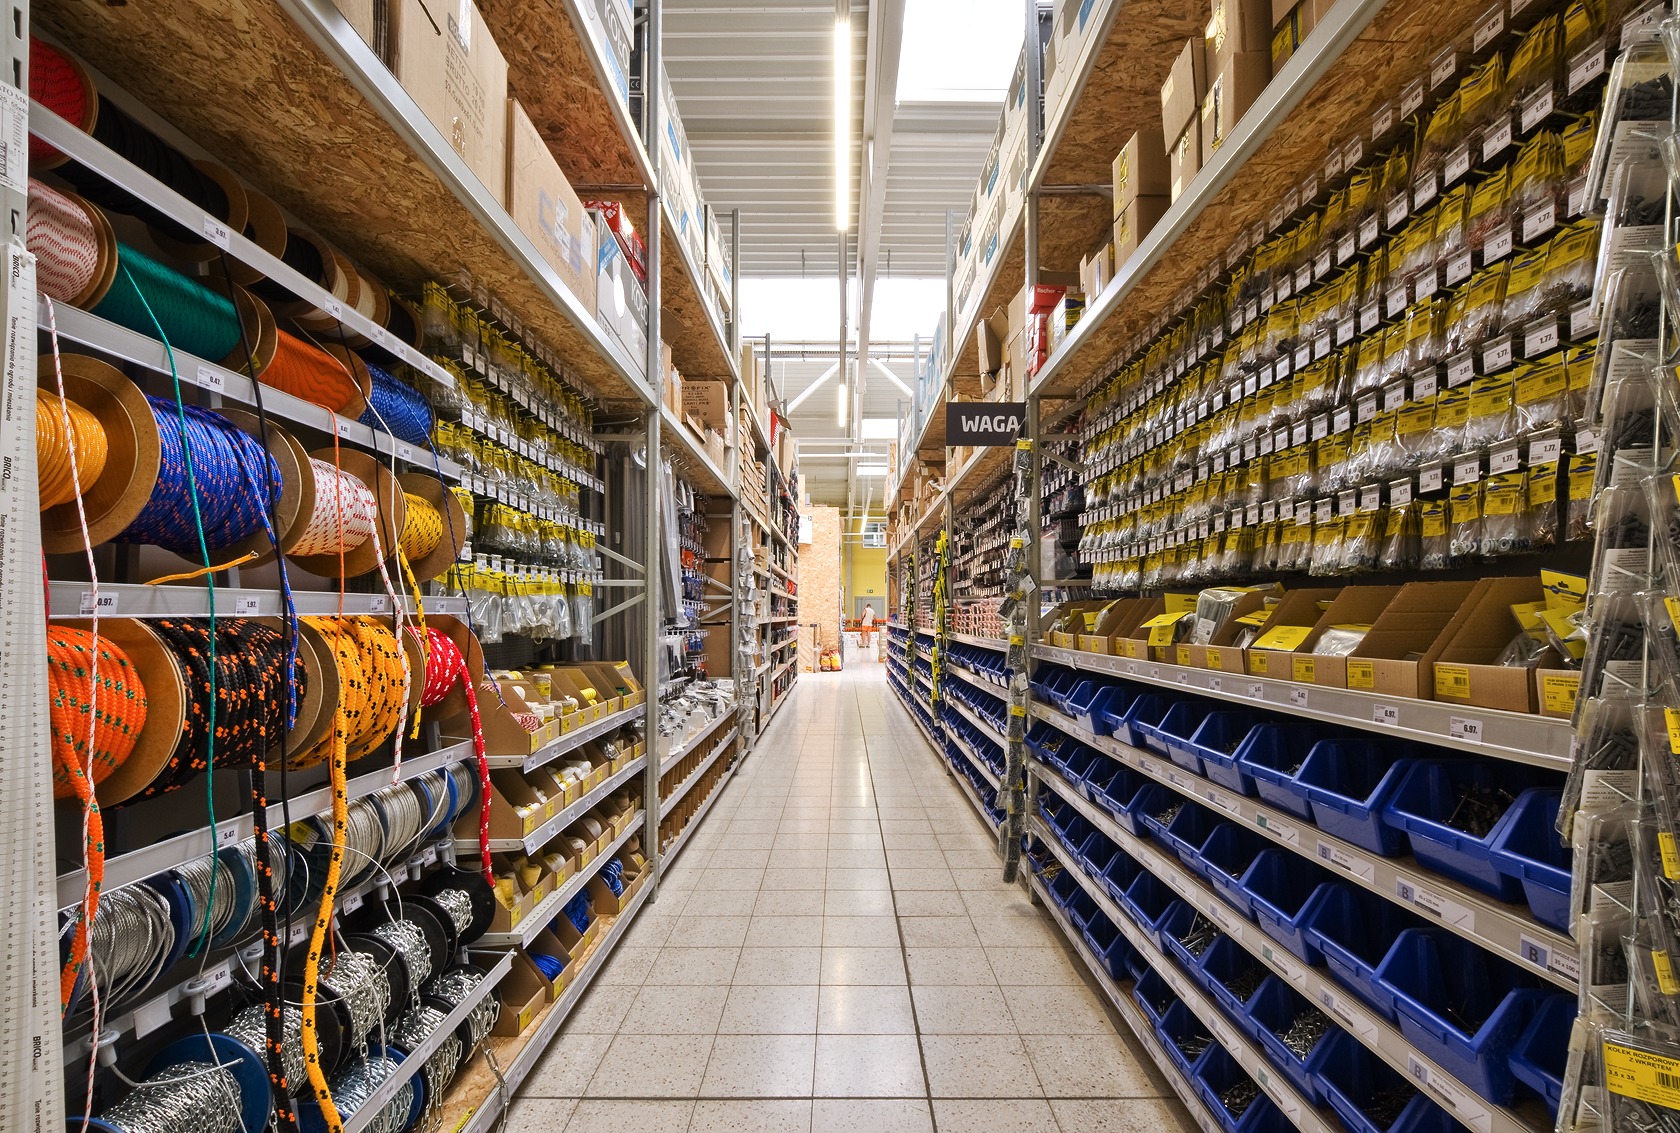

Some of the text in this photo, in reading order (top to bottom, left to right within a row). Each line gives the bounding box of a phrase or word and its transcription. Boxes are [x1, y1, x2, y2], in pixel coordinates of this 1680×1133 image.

[1585, 58, 1600, 73] 1.97.
[446, 56, 469, 96] BRUTTO
[1535, 100, 1549, 113] 1.97.
[1538, 212, 1552, 224] 1.77.
[1497, 238, 1509, 249] 1.77.
[1458, 261, 1468, 271] 1.77.
[1540, 334, 1553, 345] 1.77.
[1497, 348, 1509, 358] 1.77.
[210, 377, 221, 385] 0.47.
[961, 415, 1019, 434] WAGA
[1502, 454, 1514, 463] 1.77.
[97, 598, 113, 606] 0.97.
[1384, 709, 1396, 718] 6.97.
[1464, 725, 1478, 734] 6.97.
[224, 830, 235, 839] 5.47.
[1321, 848, 1327, 858] B
[1402, 886, 1408, 899] B
[1529, 946, 1538, 963] B
[215, 971, 227, 980] 0.97.
[33, 1036, 41, 1058] BRICO
[1633, 1052, 1679, 1067] ROZPOROWY
[1635, 1059, 1672, 1071] WKRĘTEM
[1415, 1064, 1421, 1079] B
